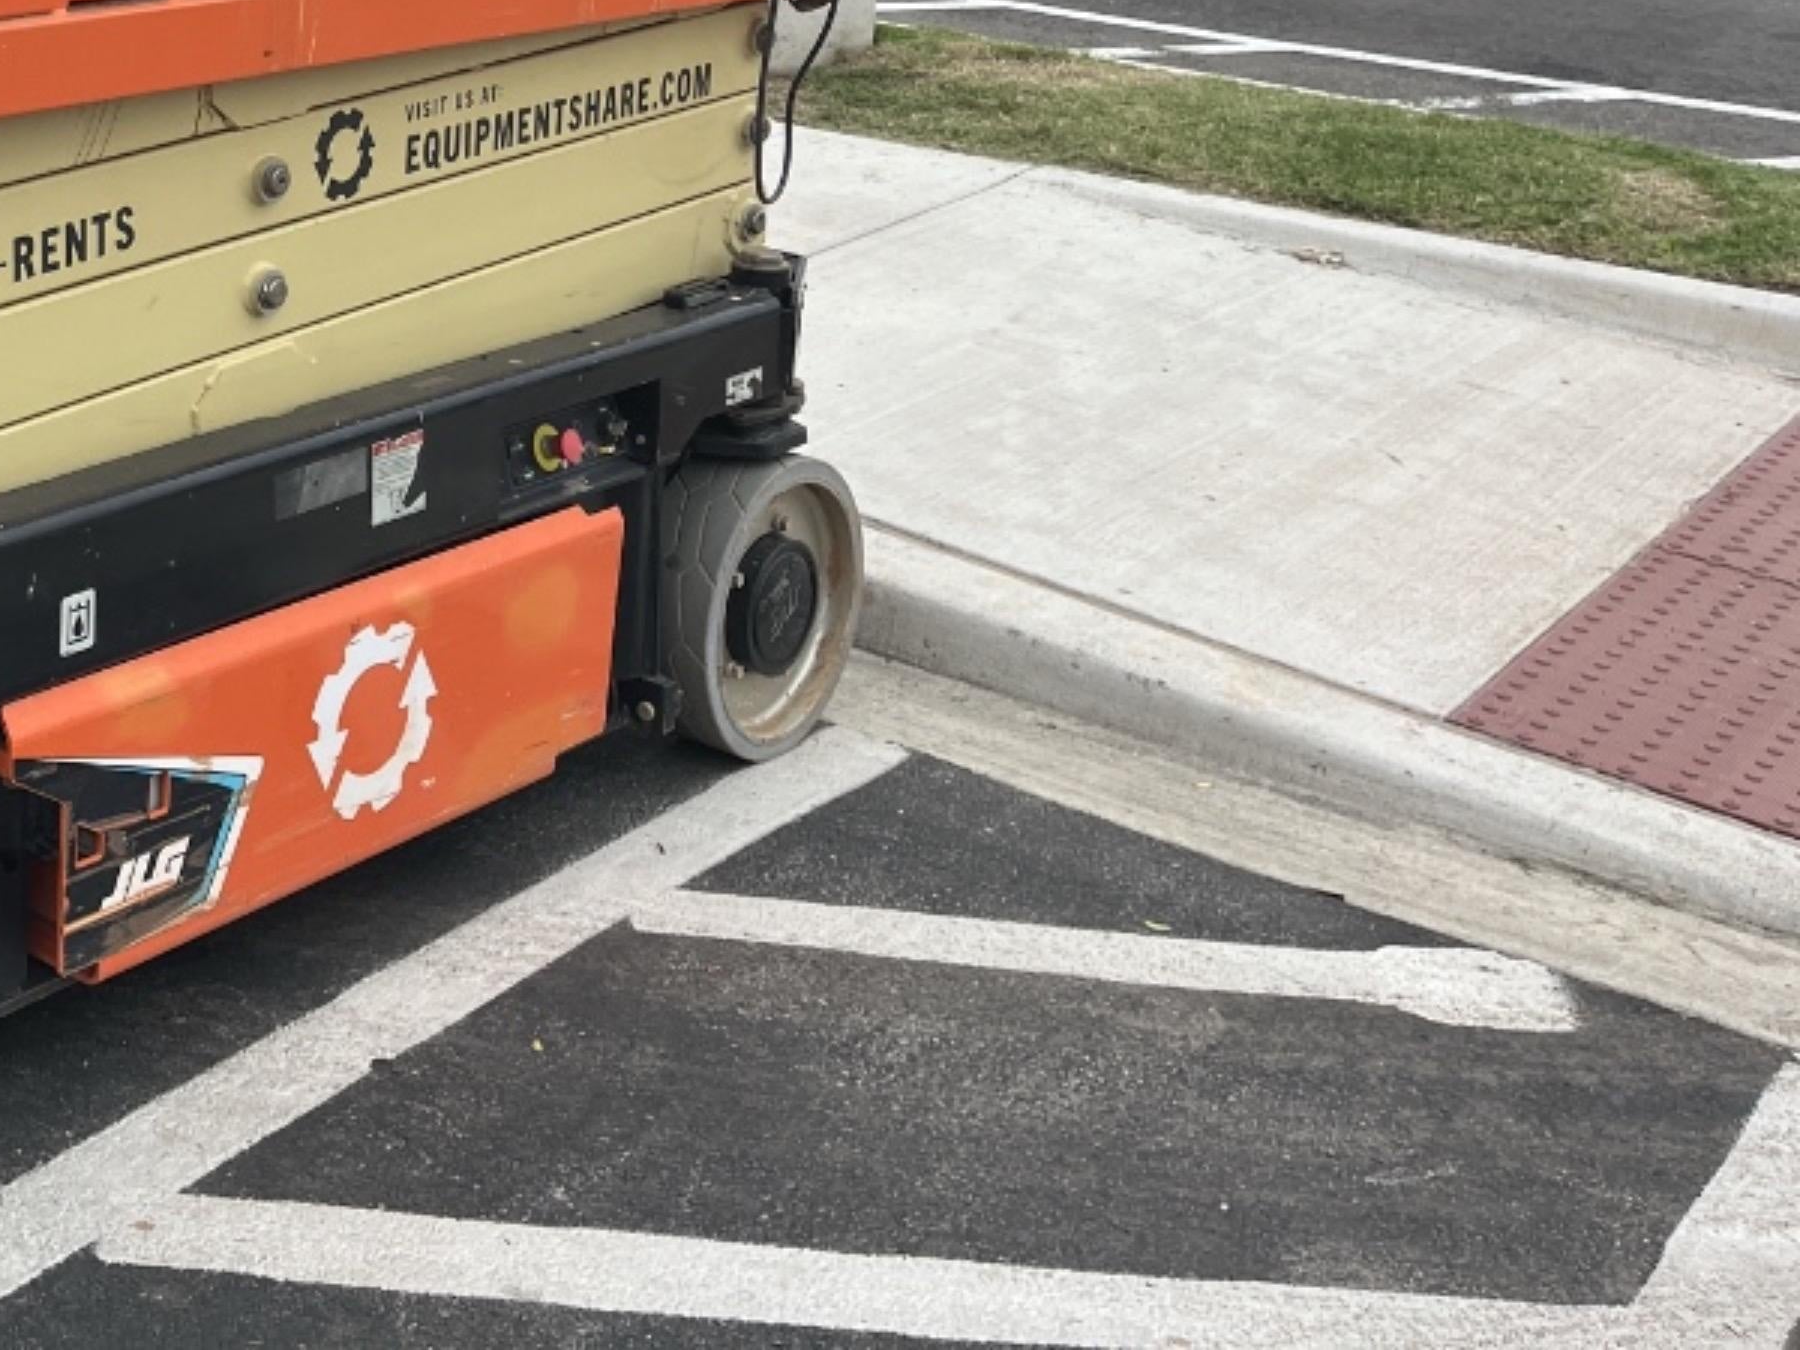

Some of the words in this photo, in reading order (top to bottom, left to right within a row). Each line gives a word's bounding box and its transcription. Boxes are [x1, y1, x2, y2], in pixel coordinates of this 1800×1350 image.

[404, 95, 449, 123] VISIT
[455, 89, 473, 109] US
[404, 62, 713, 175] EQUIPMENTSHARE.COM
[101, 835, 192, 911] JLG
